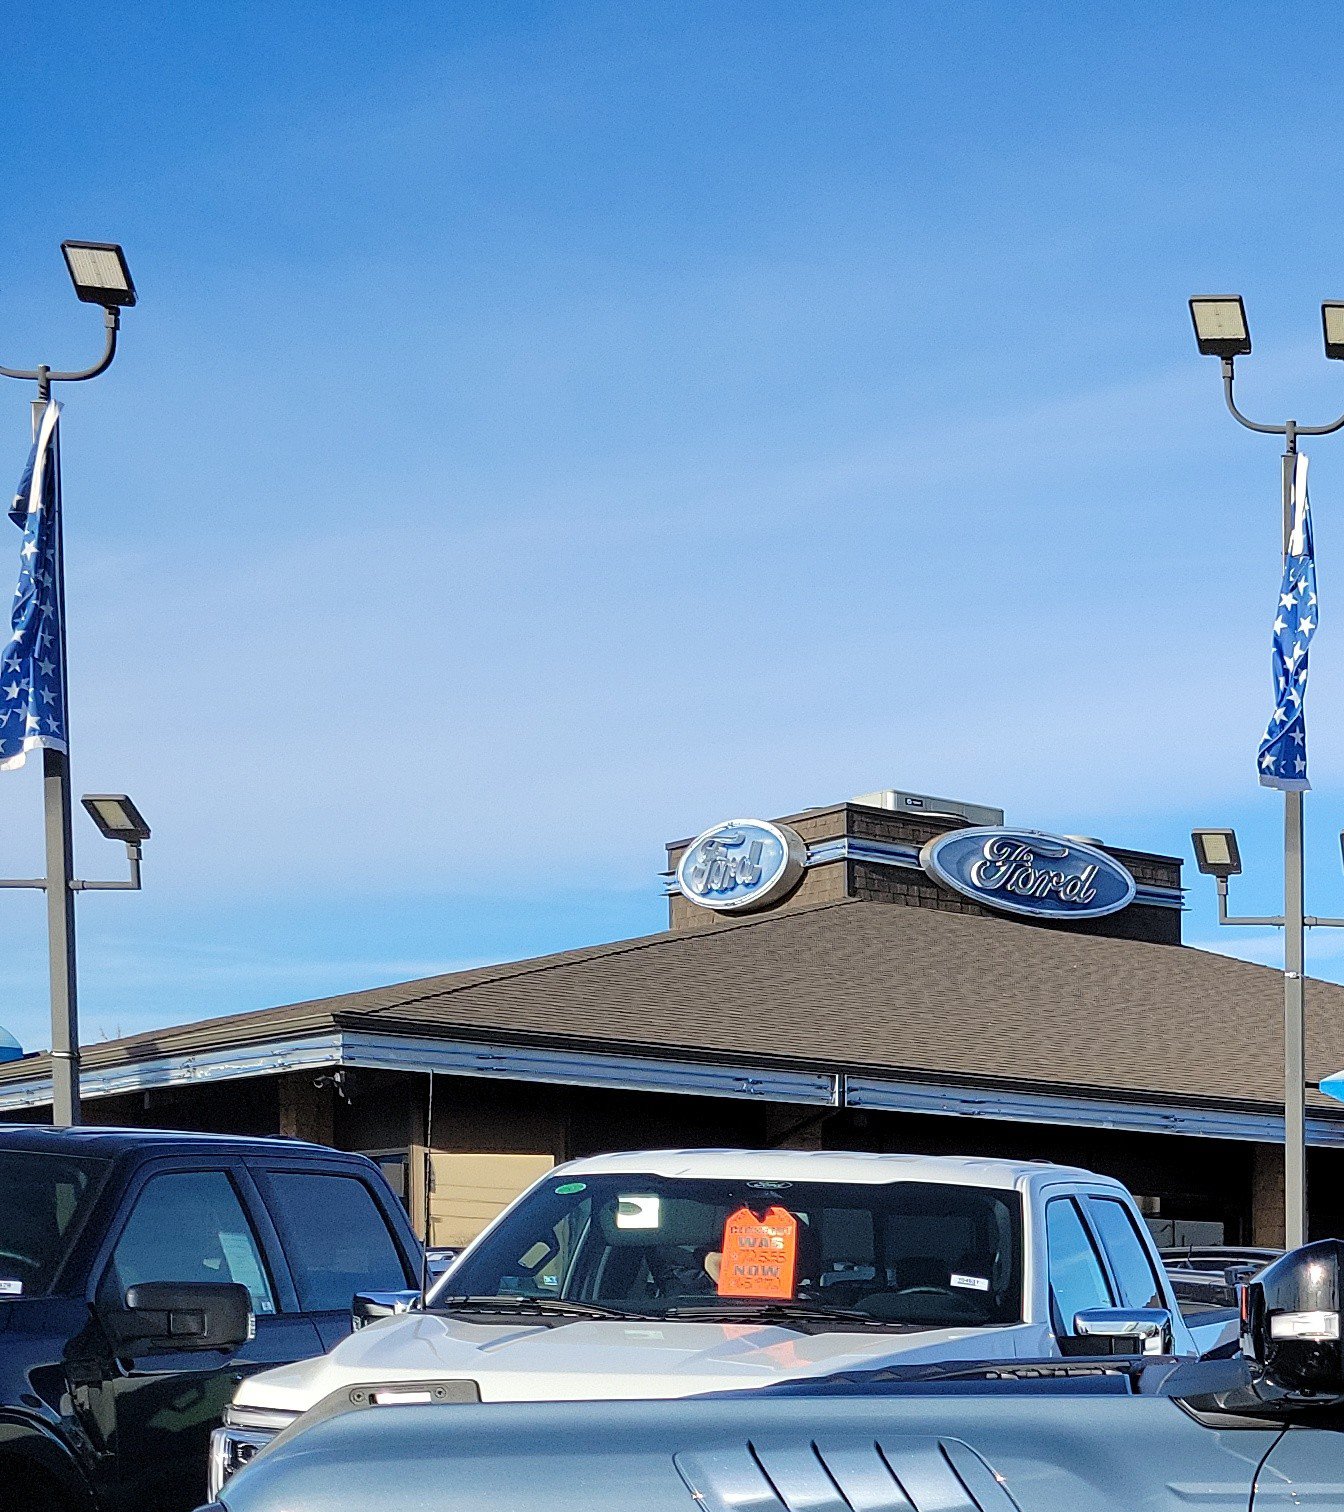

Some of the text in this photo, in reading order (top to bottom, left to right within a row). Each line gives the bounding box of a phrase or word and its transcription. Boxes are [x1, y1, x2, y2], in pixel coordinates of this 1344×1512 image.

[692, 830, 764, 894] Ford
[970, 836, 1100, 904] Ford
[738, 1237, 785, 1249] WAS
[734, 1265, 781, 1277] NOW
